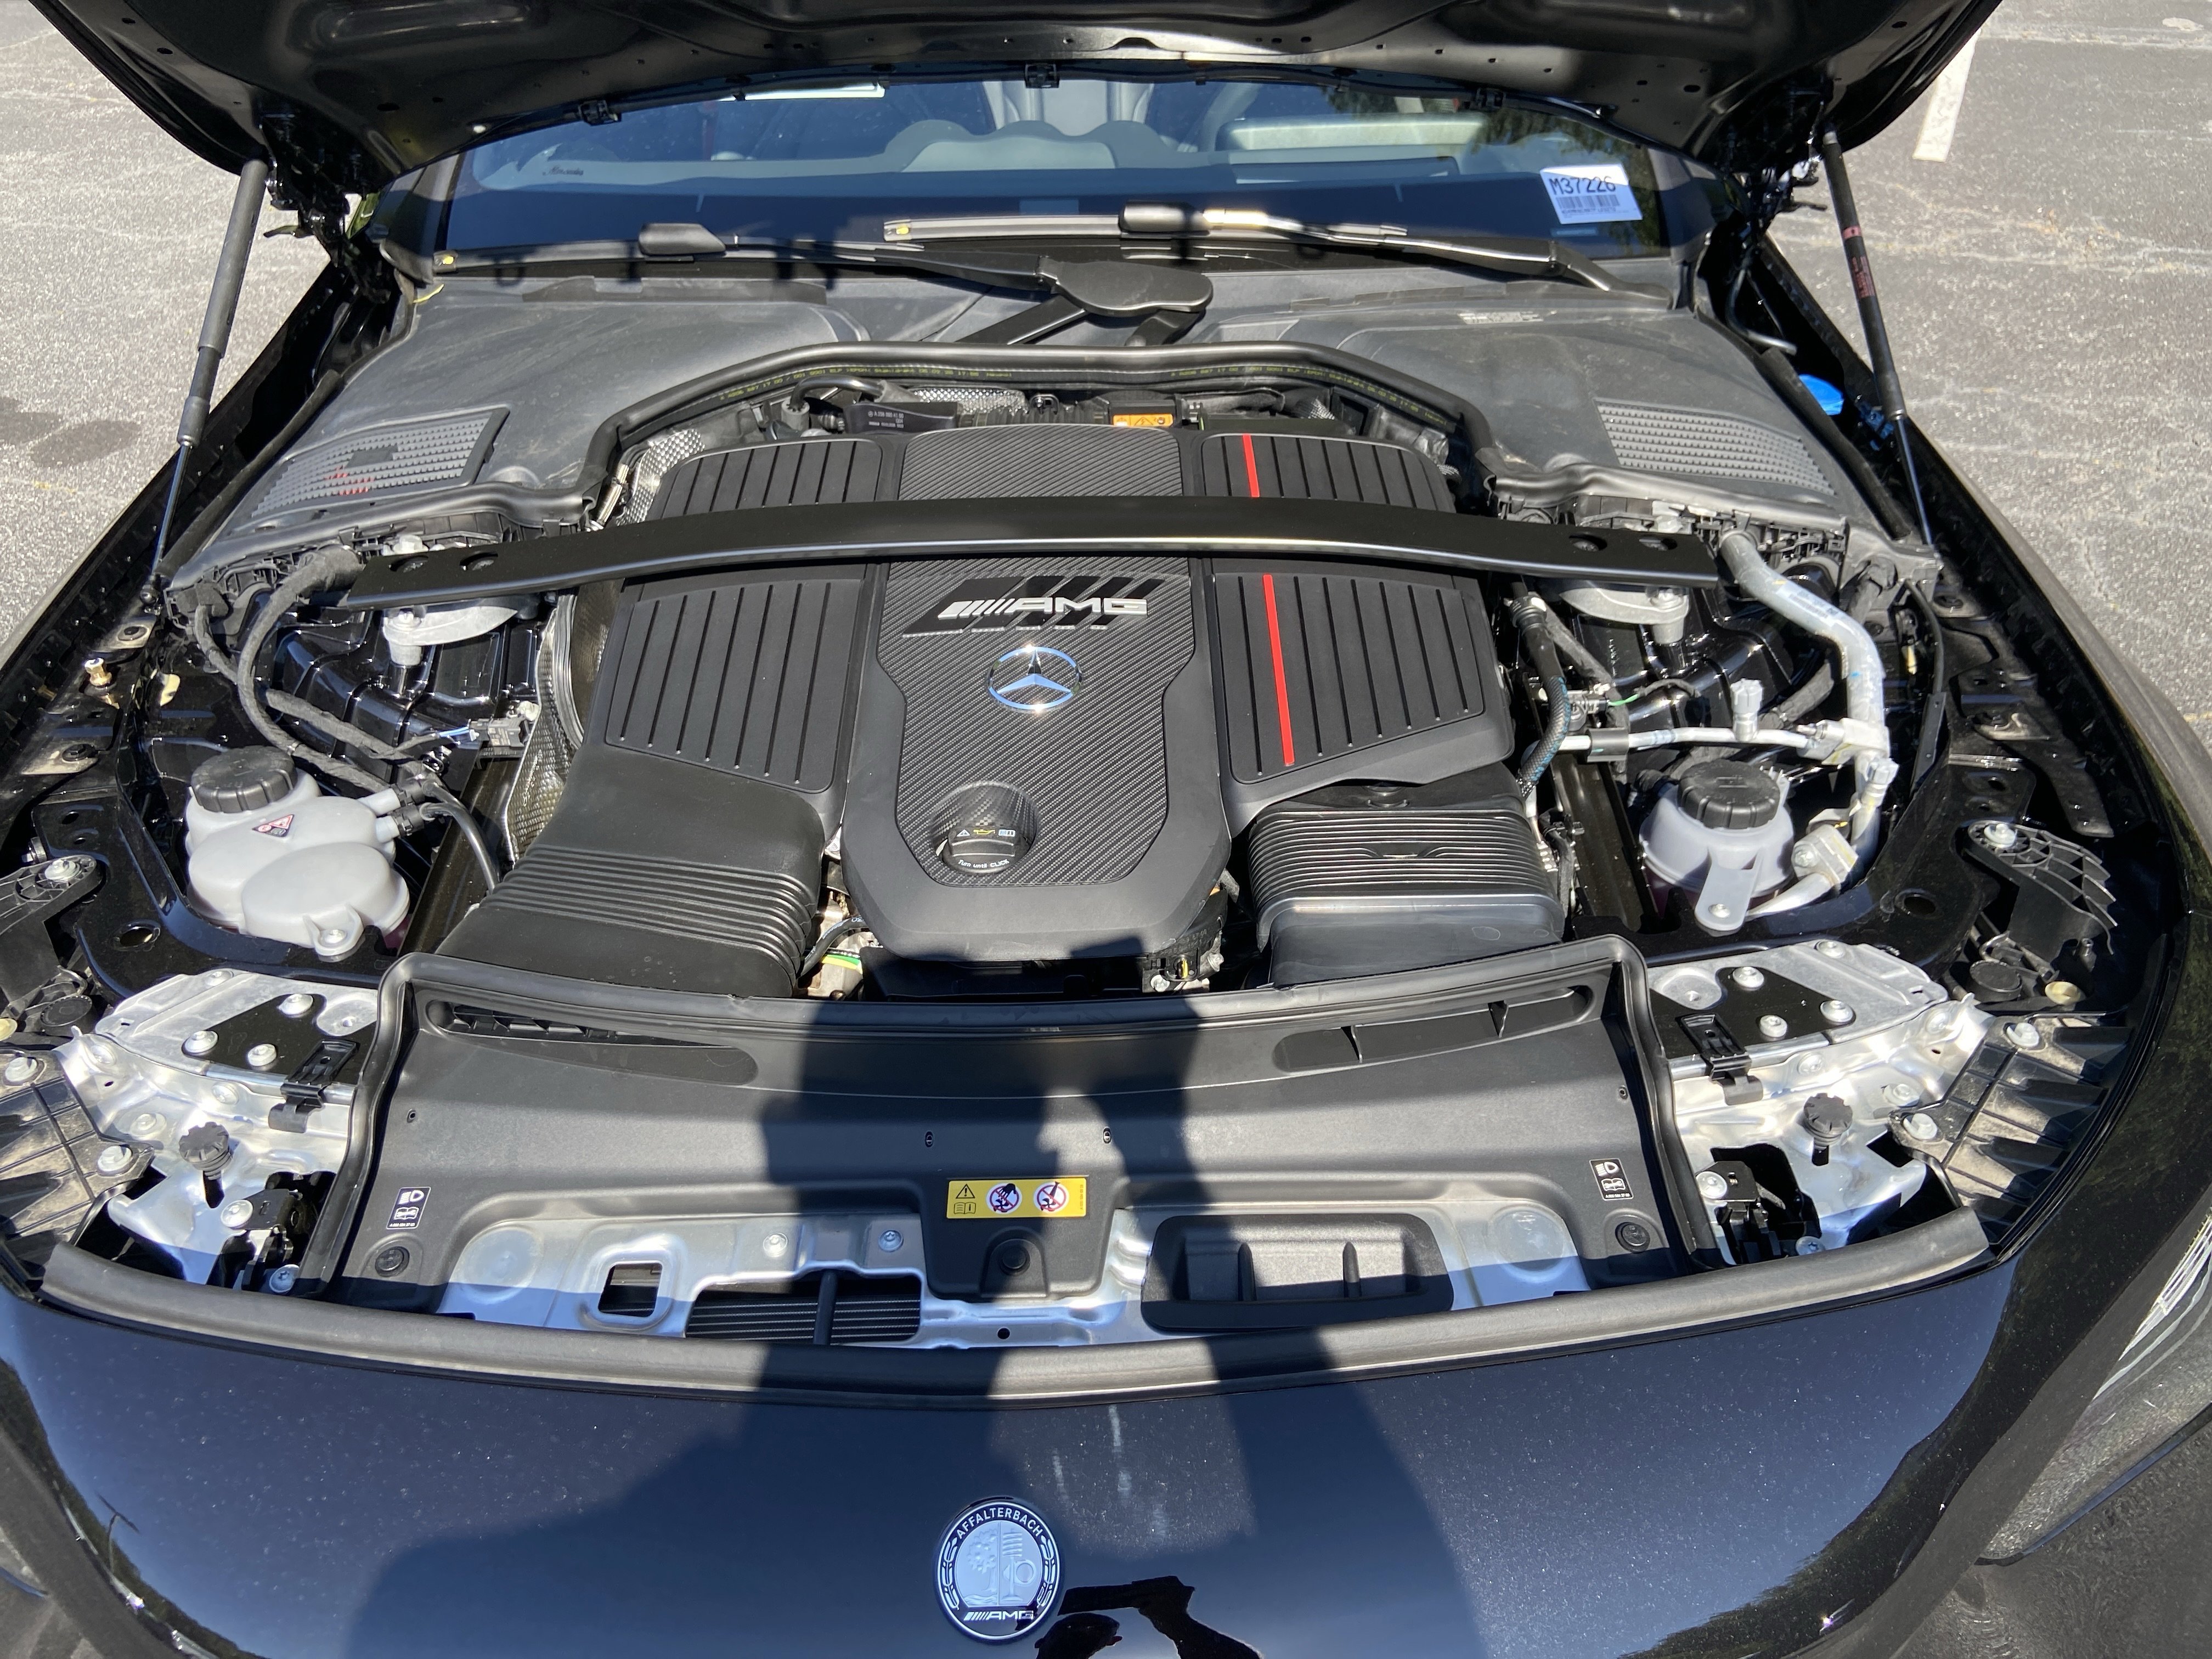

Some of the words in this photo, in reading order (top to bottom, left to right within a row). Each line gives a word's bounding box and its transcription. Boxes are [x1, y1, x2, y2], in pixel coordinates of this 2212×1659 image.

[1549, 176, 1616, 195] M37226
[990, 859, 1010, 867] CLICK
[956, 1507, 1043, 1539] AFFALTERBACH
[986, 1610, 1034, 1621] AMG
